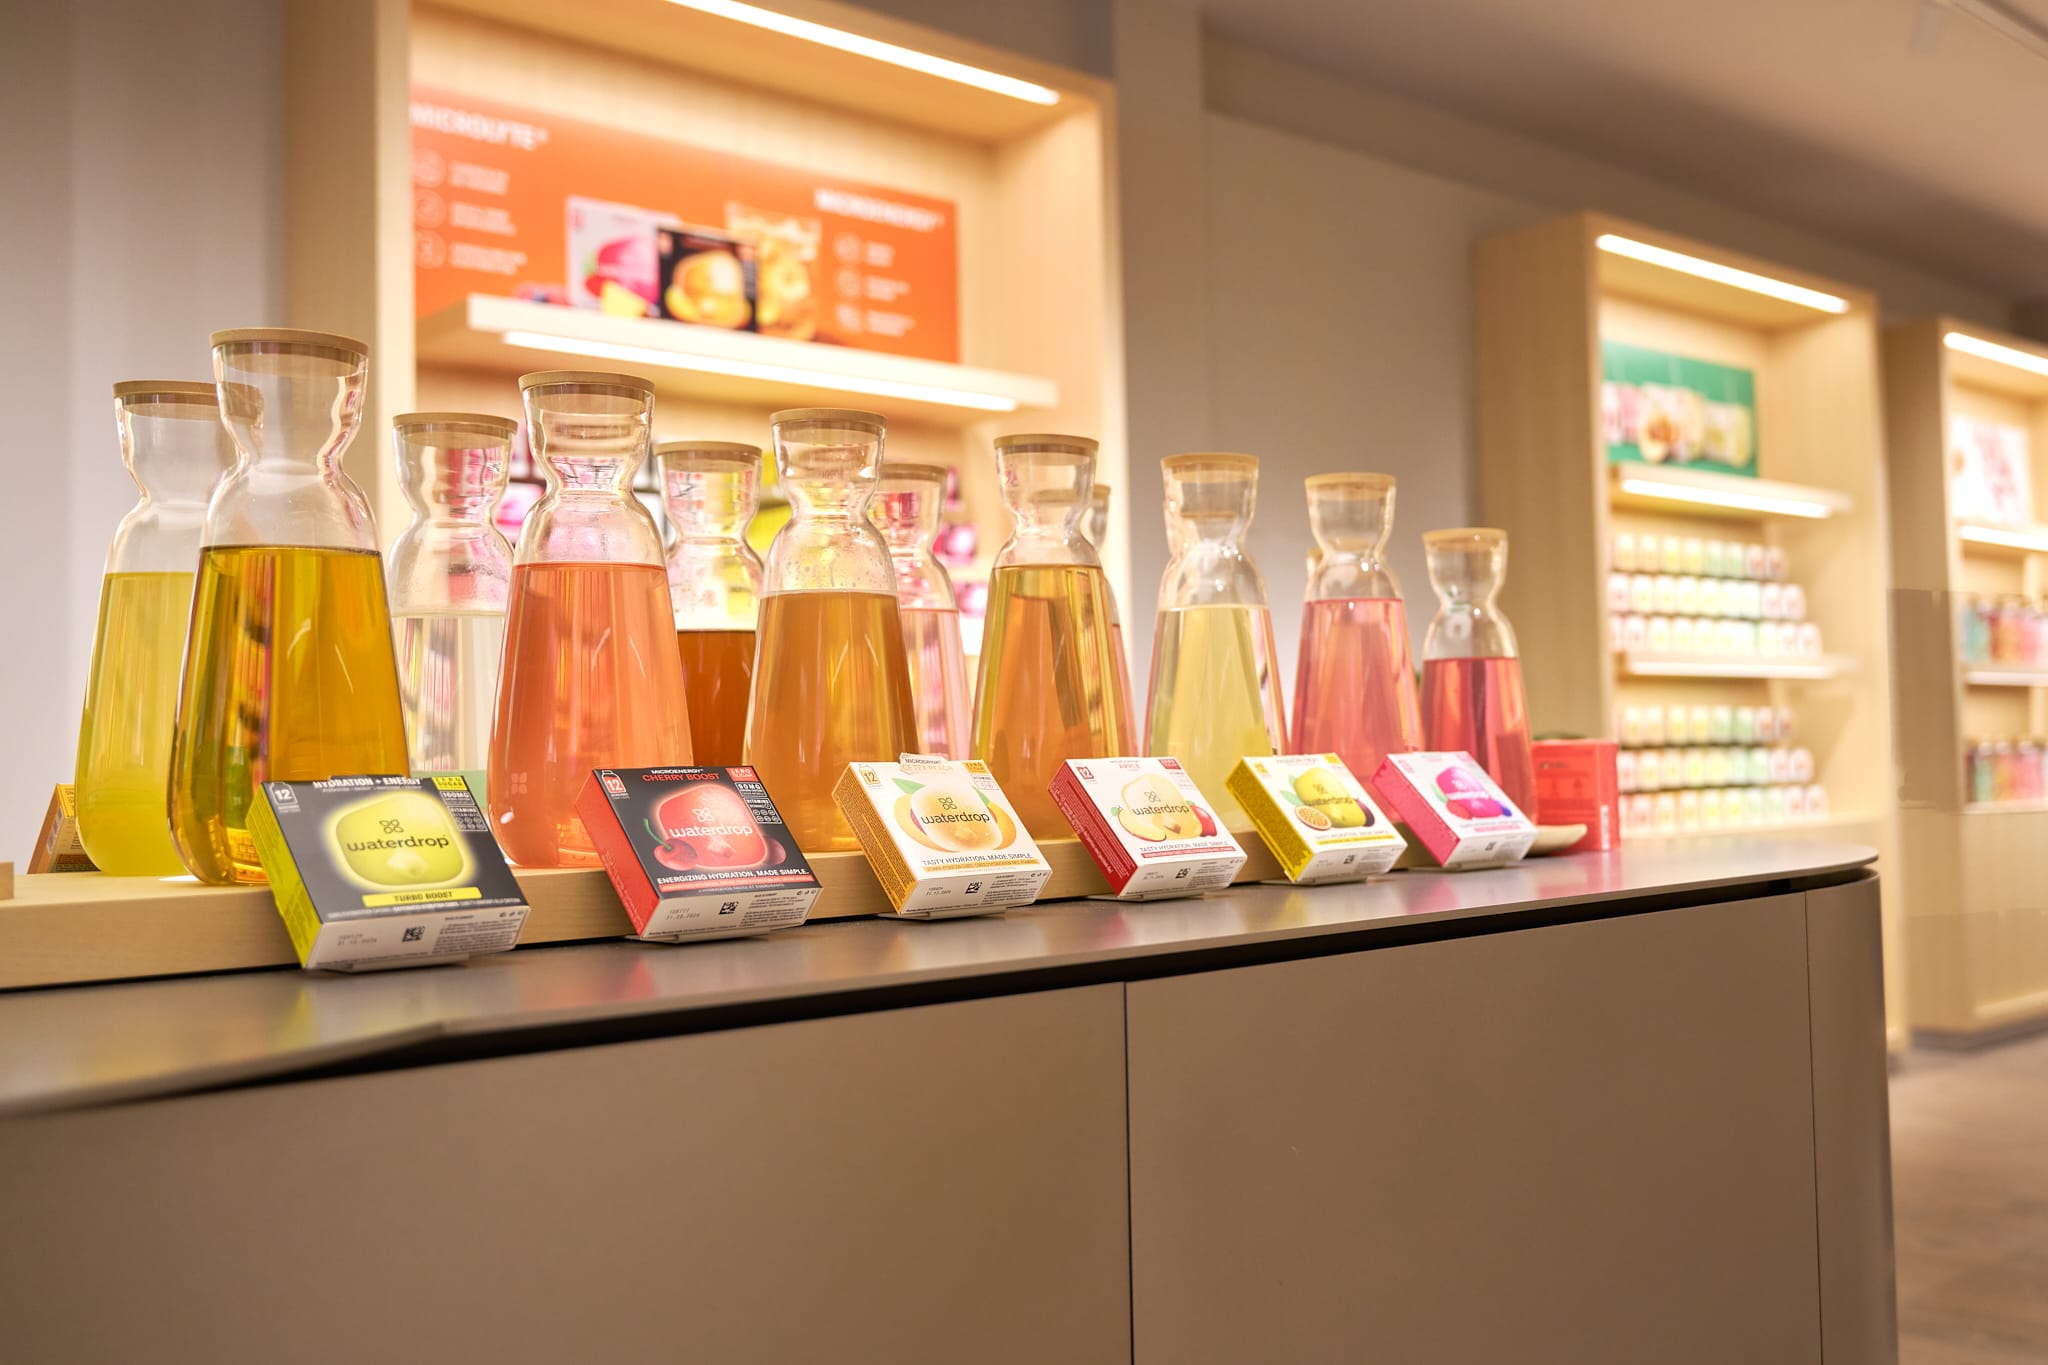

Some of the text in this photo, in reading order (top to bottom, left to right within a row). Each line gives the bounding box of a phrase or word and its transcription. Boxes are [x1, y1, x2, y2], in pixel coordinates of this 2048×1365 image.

[312, 777, 374, 789] HYDRATION
[383, 776, 421, 786] ENERGY
[642, 772, 720, 782] CHERRY BOOST
[864, 771, 878, 783] 12
[606, 778, 623, 791] 12
[275, 789, 293, 801] 12
[1132, 803, 1190, 816] waterdrop
[920, 811, 990, 825] waterdrop
[668, 822, 753, 839] waterdrop
[346, 834, 450, 852] waterdrop
[922, 858, 945, 867] TASTY
[657, 873, 708, 885] ENERGIZING
[757, 869, 779, 877] MADE
[394, 891, 453, 902] TURBO BOOST
